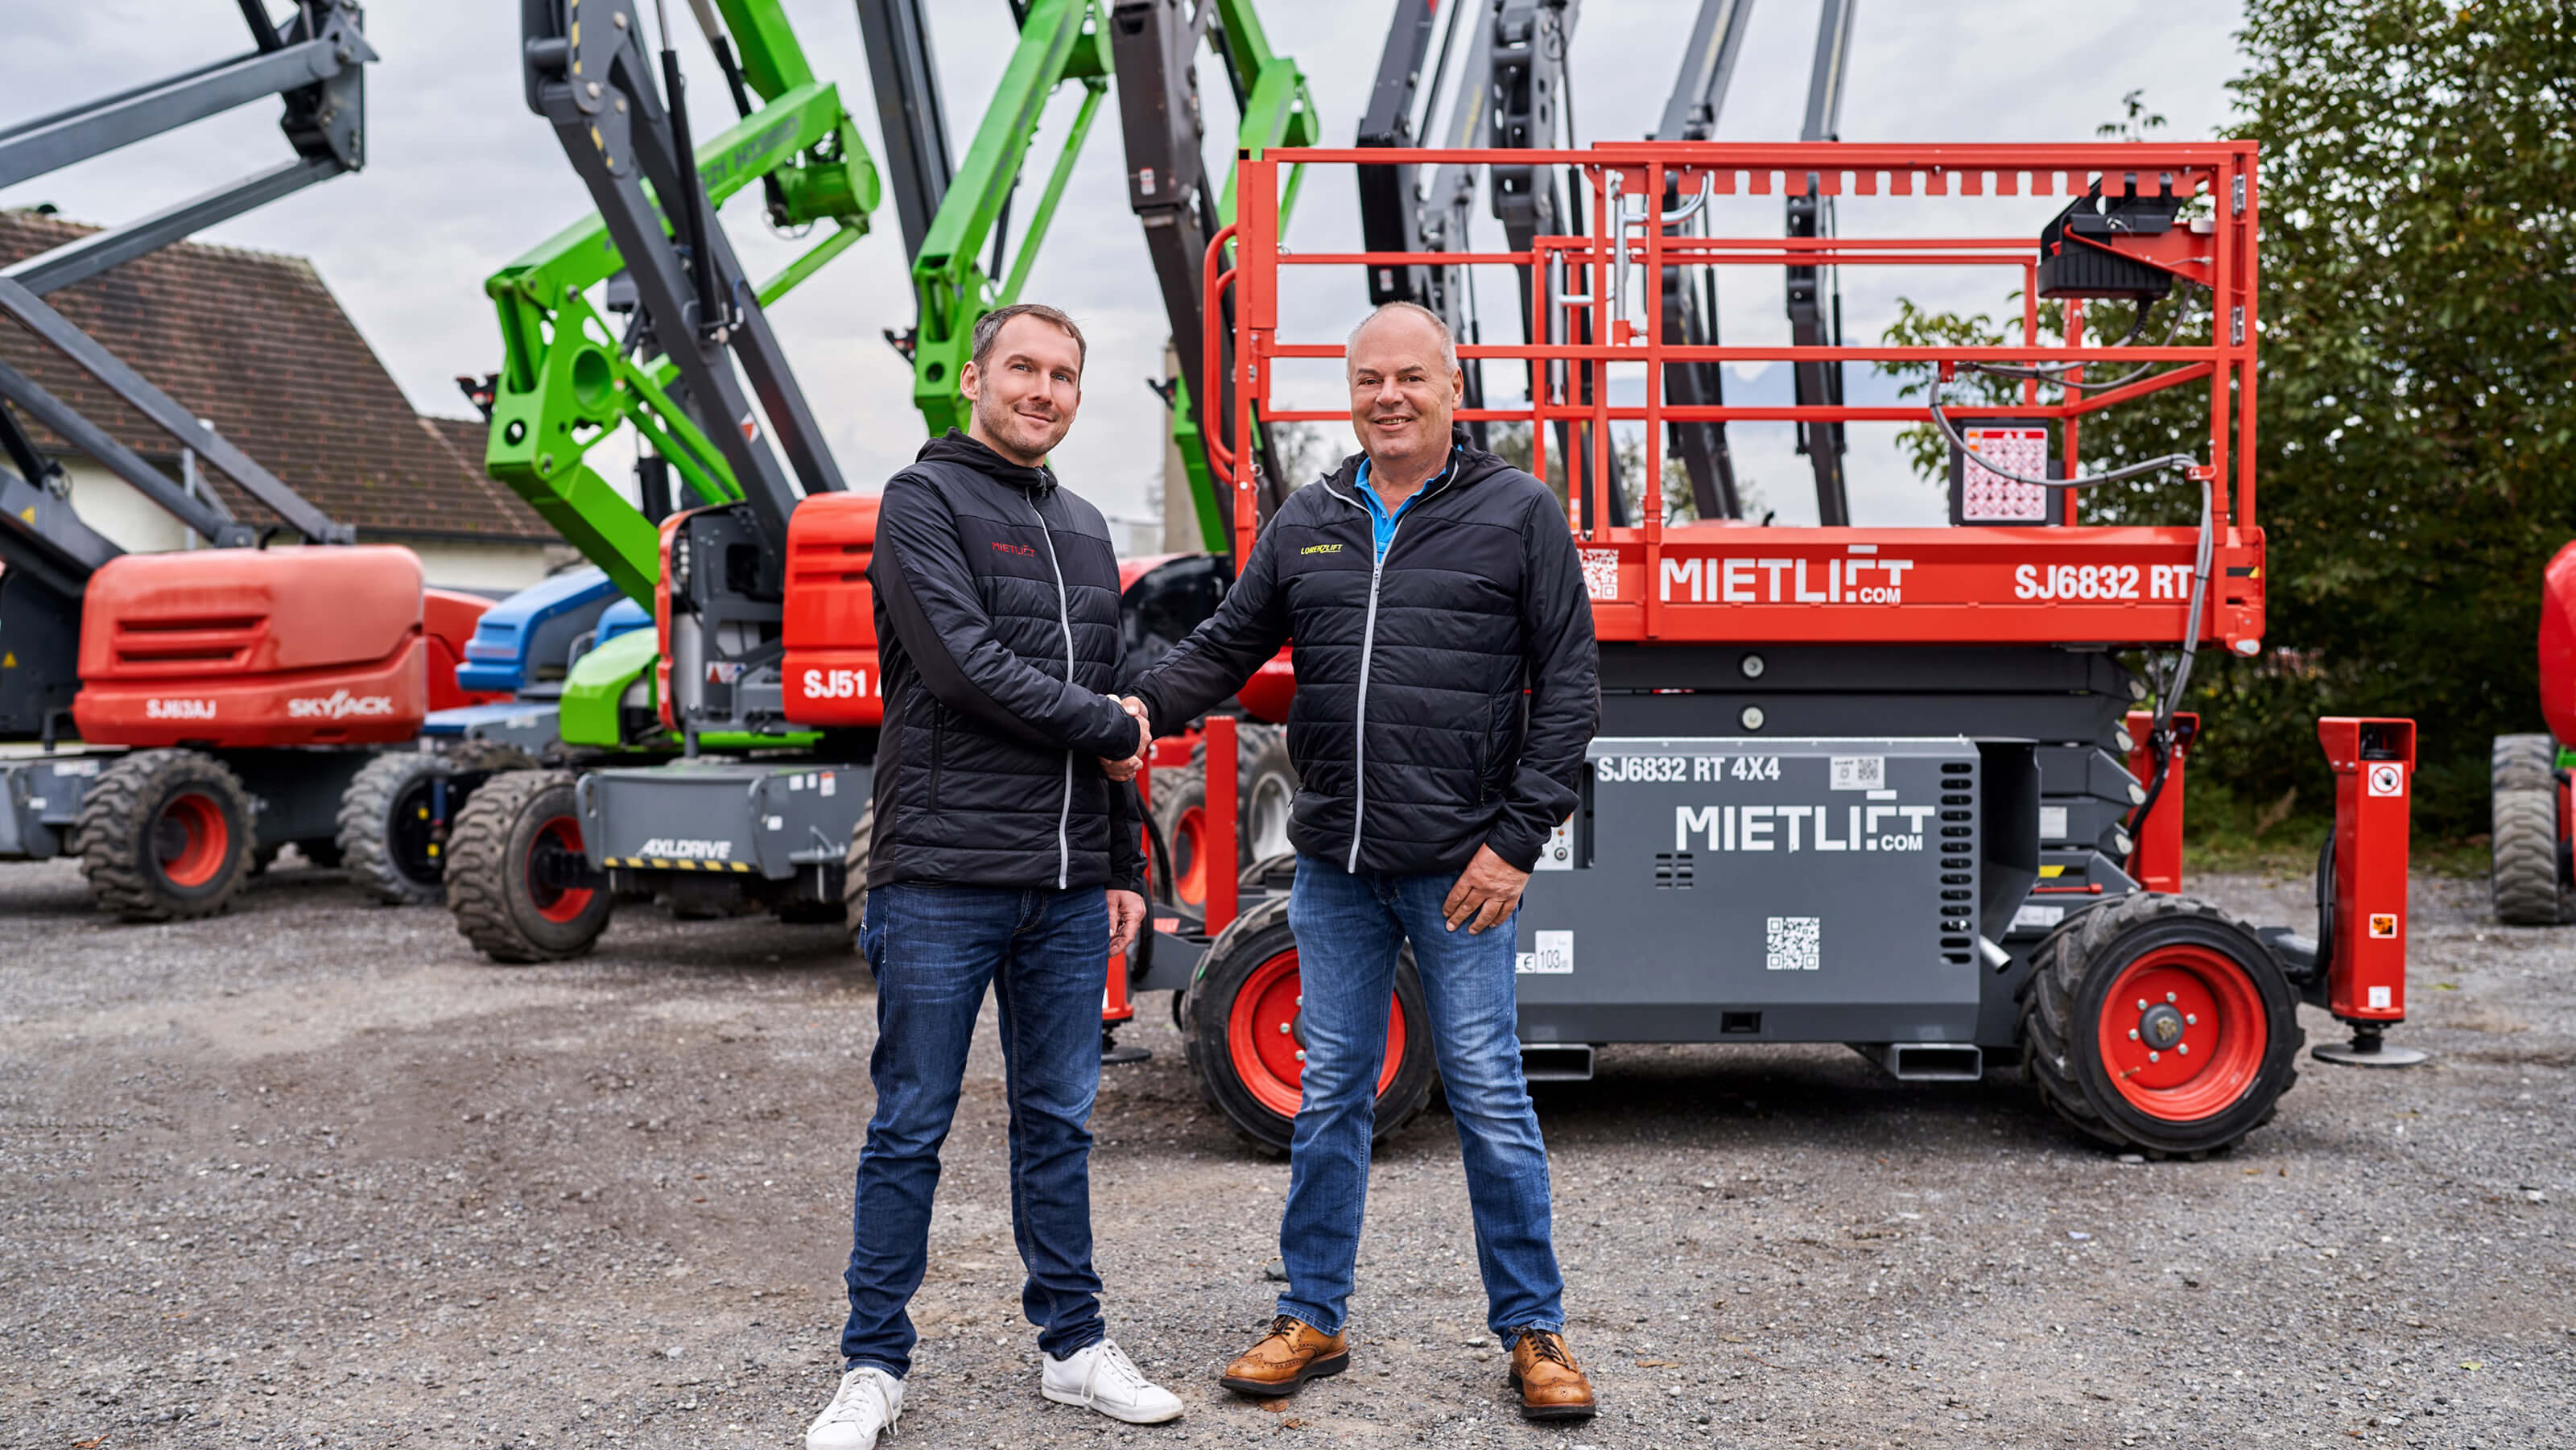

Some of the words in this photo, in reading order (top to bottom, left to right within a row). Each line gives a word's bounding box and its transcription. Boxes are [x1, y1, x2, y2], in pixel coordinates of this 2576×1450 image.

[1659, 544, 1913, 603] MIETLIFT
[2015, 564, 2140, 599] SJ6832
[2150, 565, 2194, 599] RT
[803, 669, 867, 698] SJ51
[287, 689, 393, 720] SKYJACK
[1597, 757, 1686, 782] SJ6832
[1695, 757, 1725, 782] RT
[1731, 757, 1781, 781] 4X4
[1676, 789, 1935, 851] MIETLIFT
[635, 838, 732, 859] AXLDRIVE
[1540, 949, 1560, 969] 103
